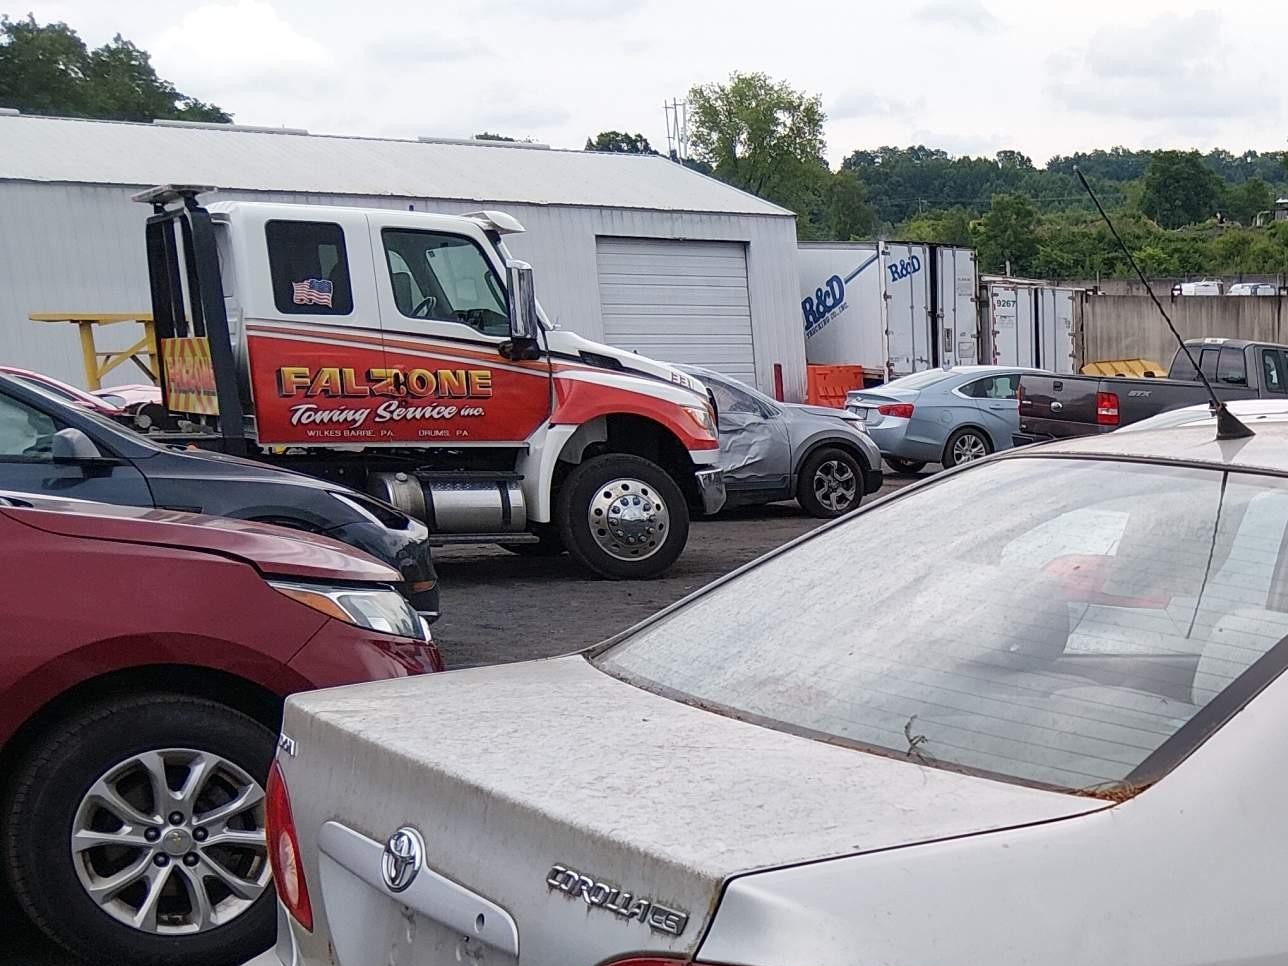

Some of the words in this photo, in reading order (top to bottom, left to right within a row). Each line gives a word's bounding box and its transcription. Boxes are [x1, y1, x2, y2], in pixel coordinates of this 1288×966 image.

[887, 255, 921, 282] R&D
[801, 275, 845, 331] R&D
[996, 299, 1017, 308] 9267
[277, 366, 493, 399] FALZONE
[290, 404, 371, 429] Towing
[374, 400, 459, 423] Service
[460, 405, 486, 416] inc.
[546, 863, 651, 924] COROLLA
